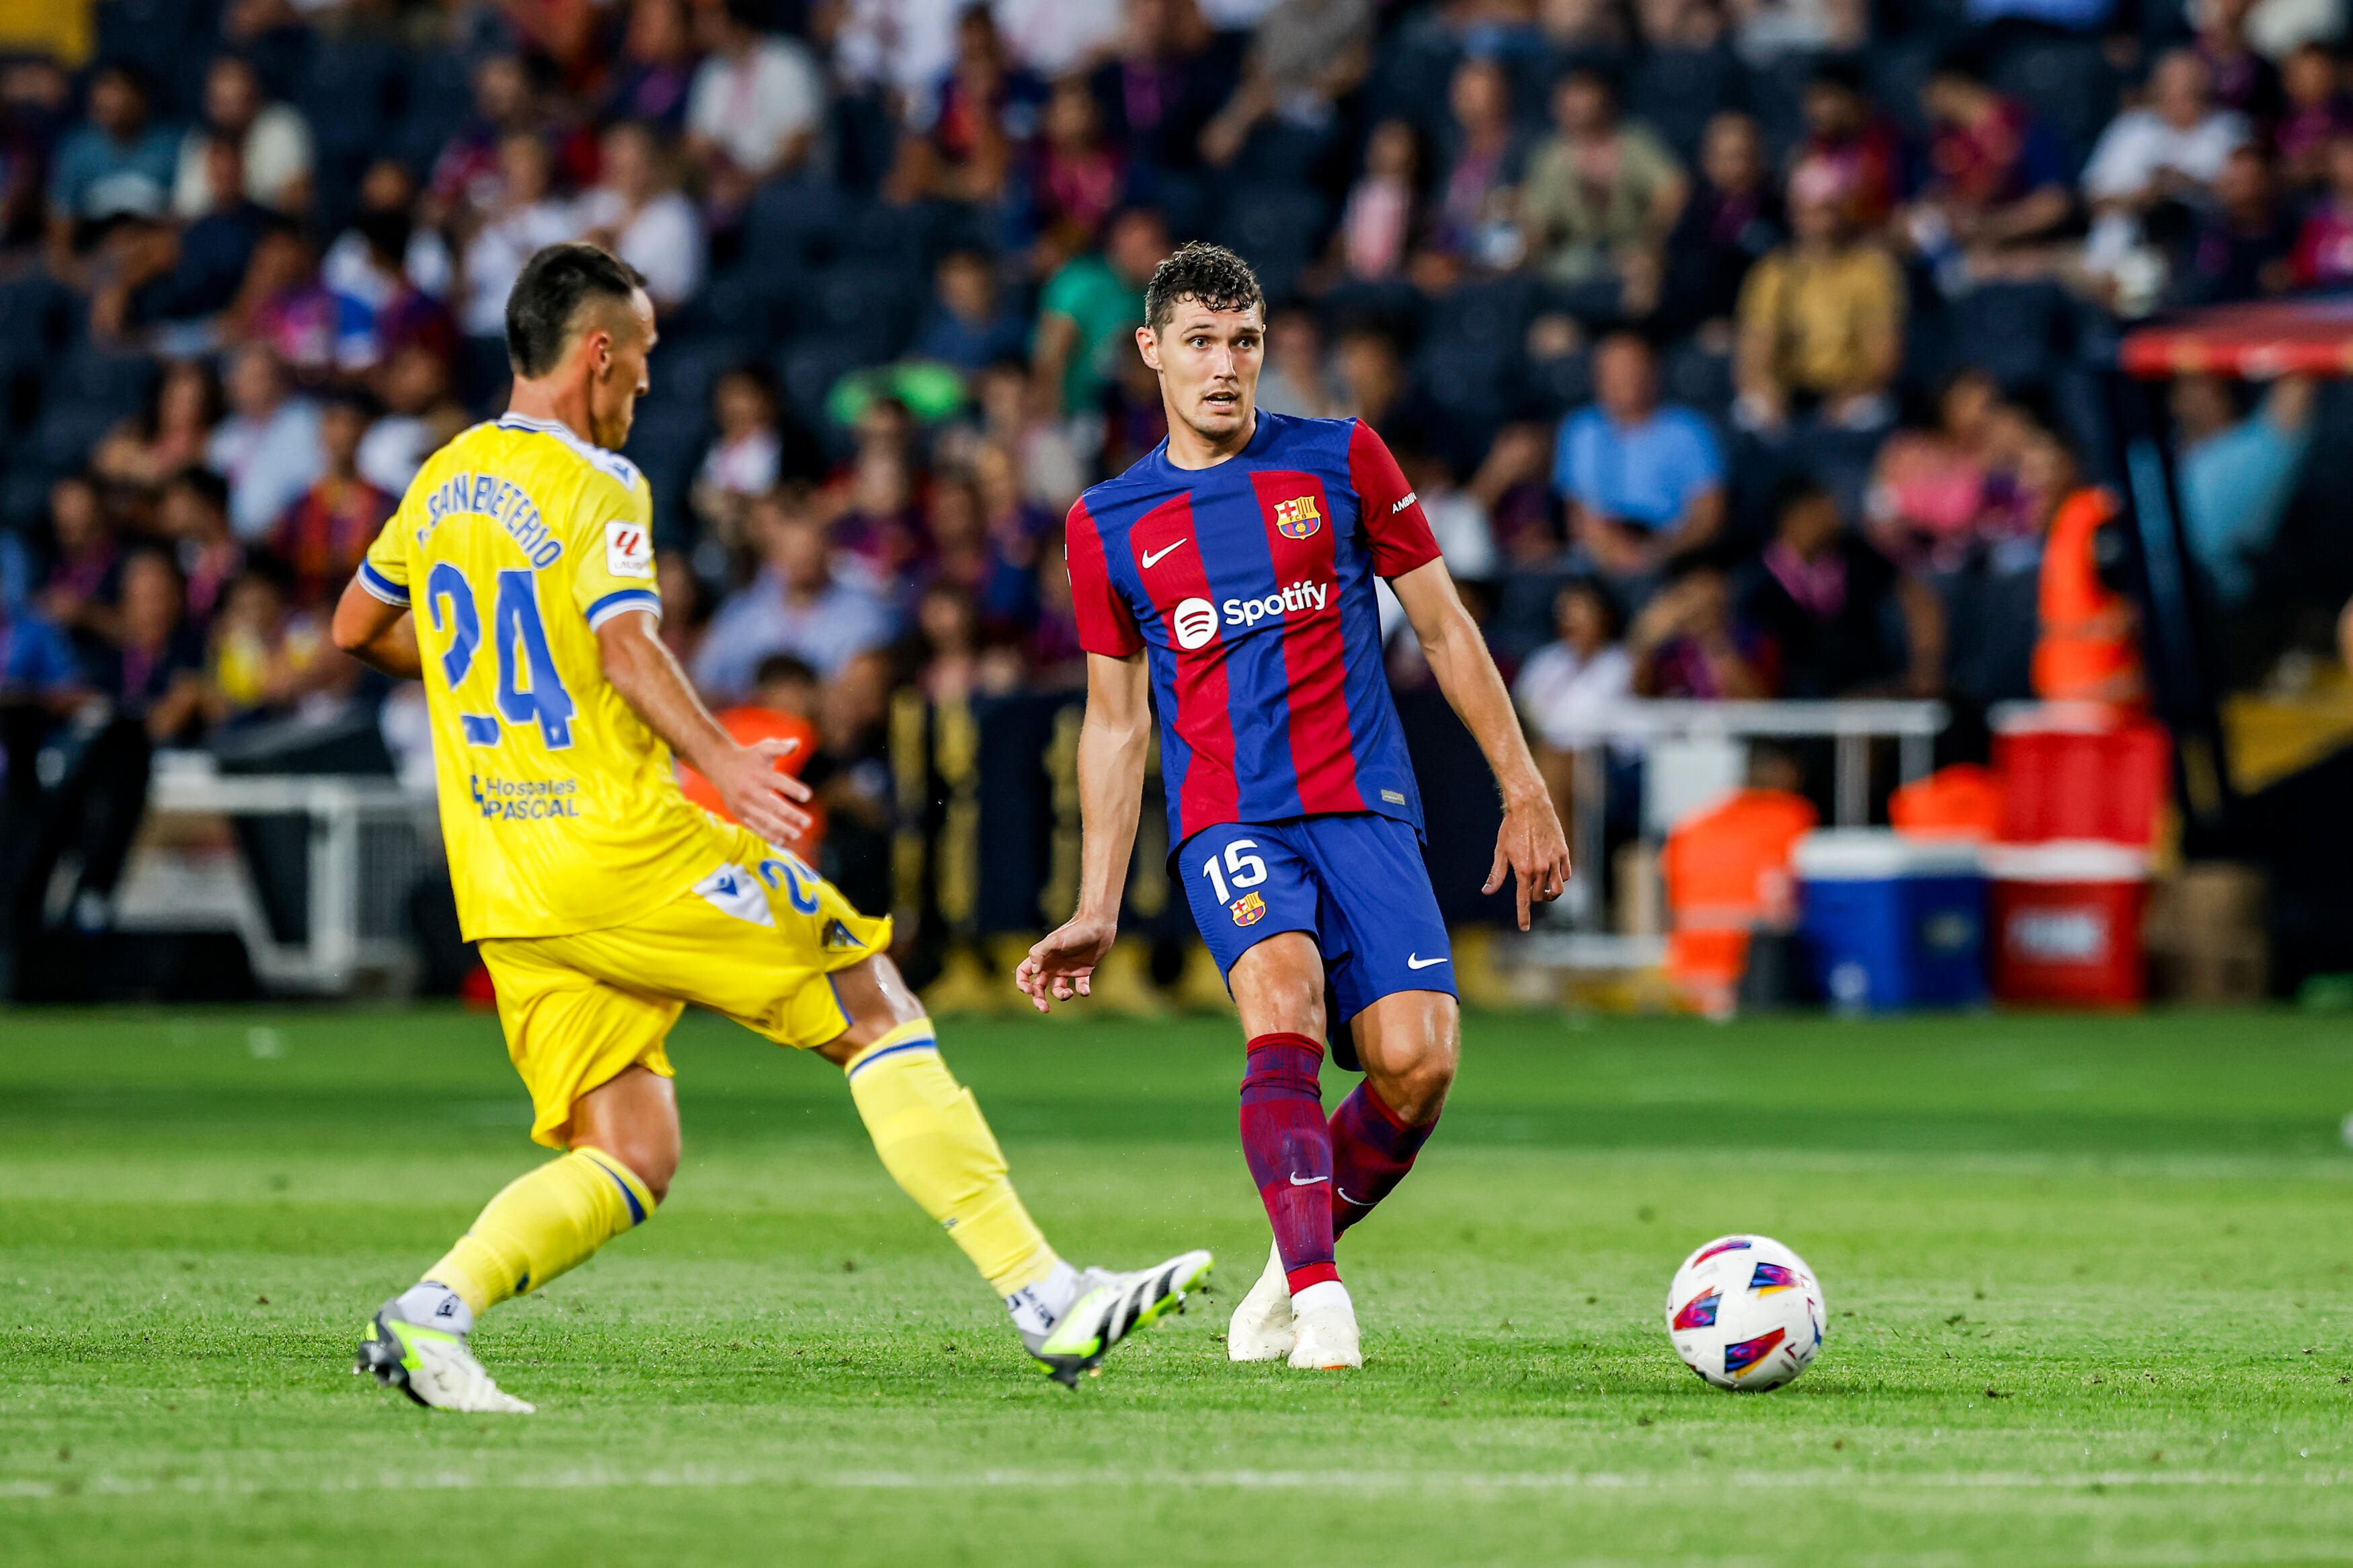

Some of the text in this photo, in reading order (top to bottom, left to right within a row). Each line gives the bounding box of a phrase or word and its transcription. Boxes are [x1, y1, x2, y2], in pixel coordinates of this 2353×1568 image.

[1222, 579, 1328, 628] Spotify
[427, 562, 577, 750] 24
[1203, 839, 1268, 906] 15
